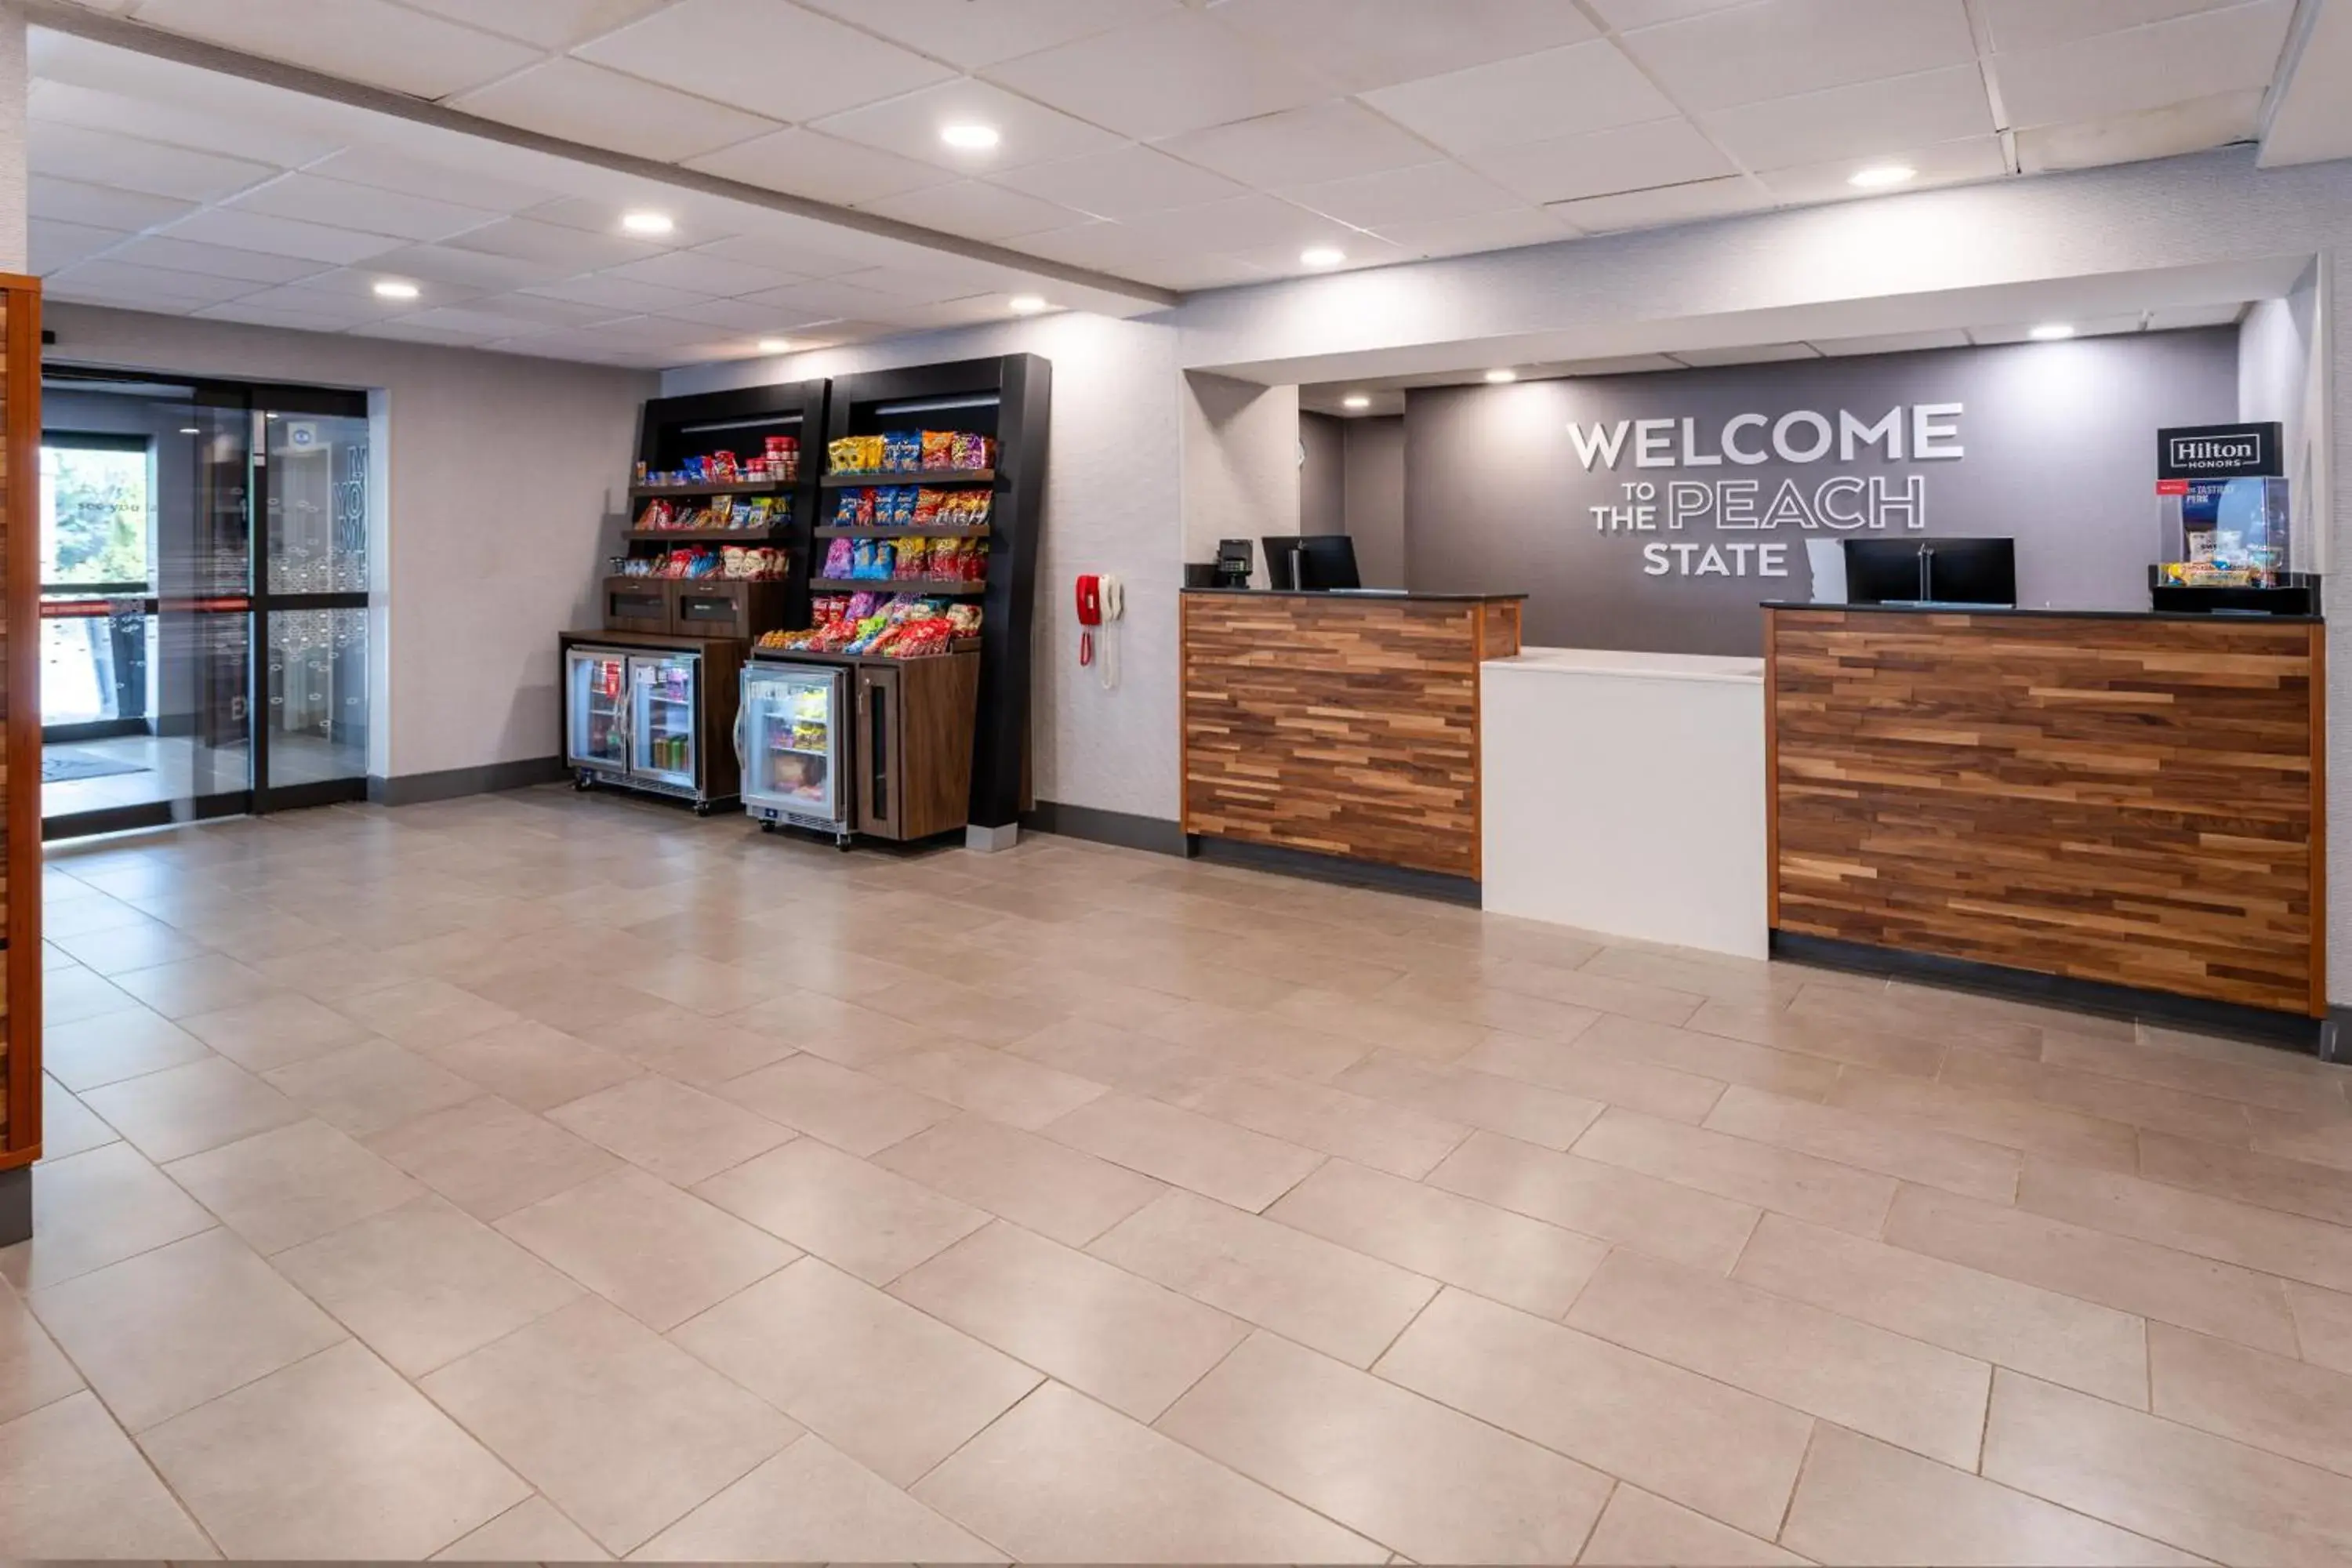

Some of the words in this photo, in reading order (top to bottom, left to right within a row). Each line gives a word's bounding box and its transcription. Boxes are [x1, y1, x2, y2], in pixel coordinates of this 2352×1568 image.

[1566, 402, 1965, 471] WELCOME
[2177, 442, 2252, 460] Hilton
[2188, 460, 2241, 469] HONORS
[1621, 481, 1655, 501] TO
[1668, 475, 1926, 530] PEACH
[1589, 505, 1656, 531] THE
[1643, 543, 1788, 577] STATE
